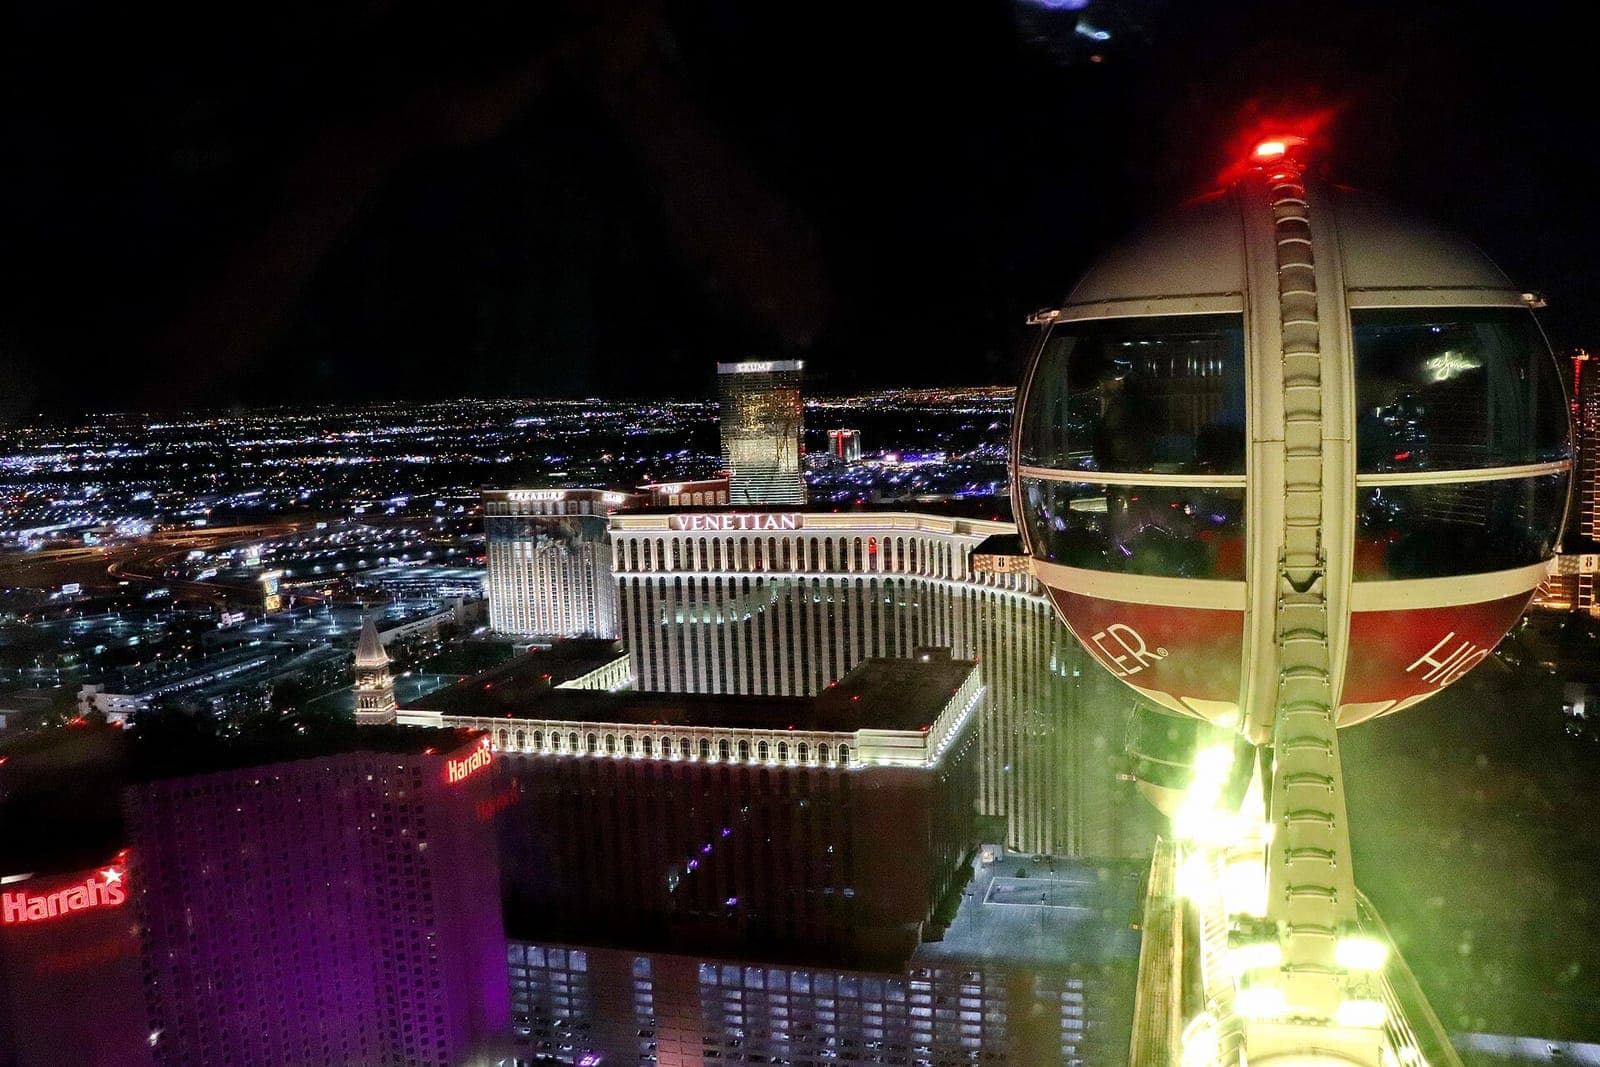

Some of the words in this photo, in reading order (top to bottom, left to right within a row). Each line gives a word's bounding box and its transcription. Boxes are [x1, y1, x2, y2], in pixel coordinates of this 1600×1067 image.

[736, 362, 773, 373] TRUMP
[507, 491, 564, 501] TREASURE
[678, 514, 796, 530] VENETIAN
[998, 556, 1005, 568] 8
[1585, 556, 1593, 568] 8
